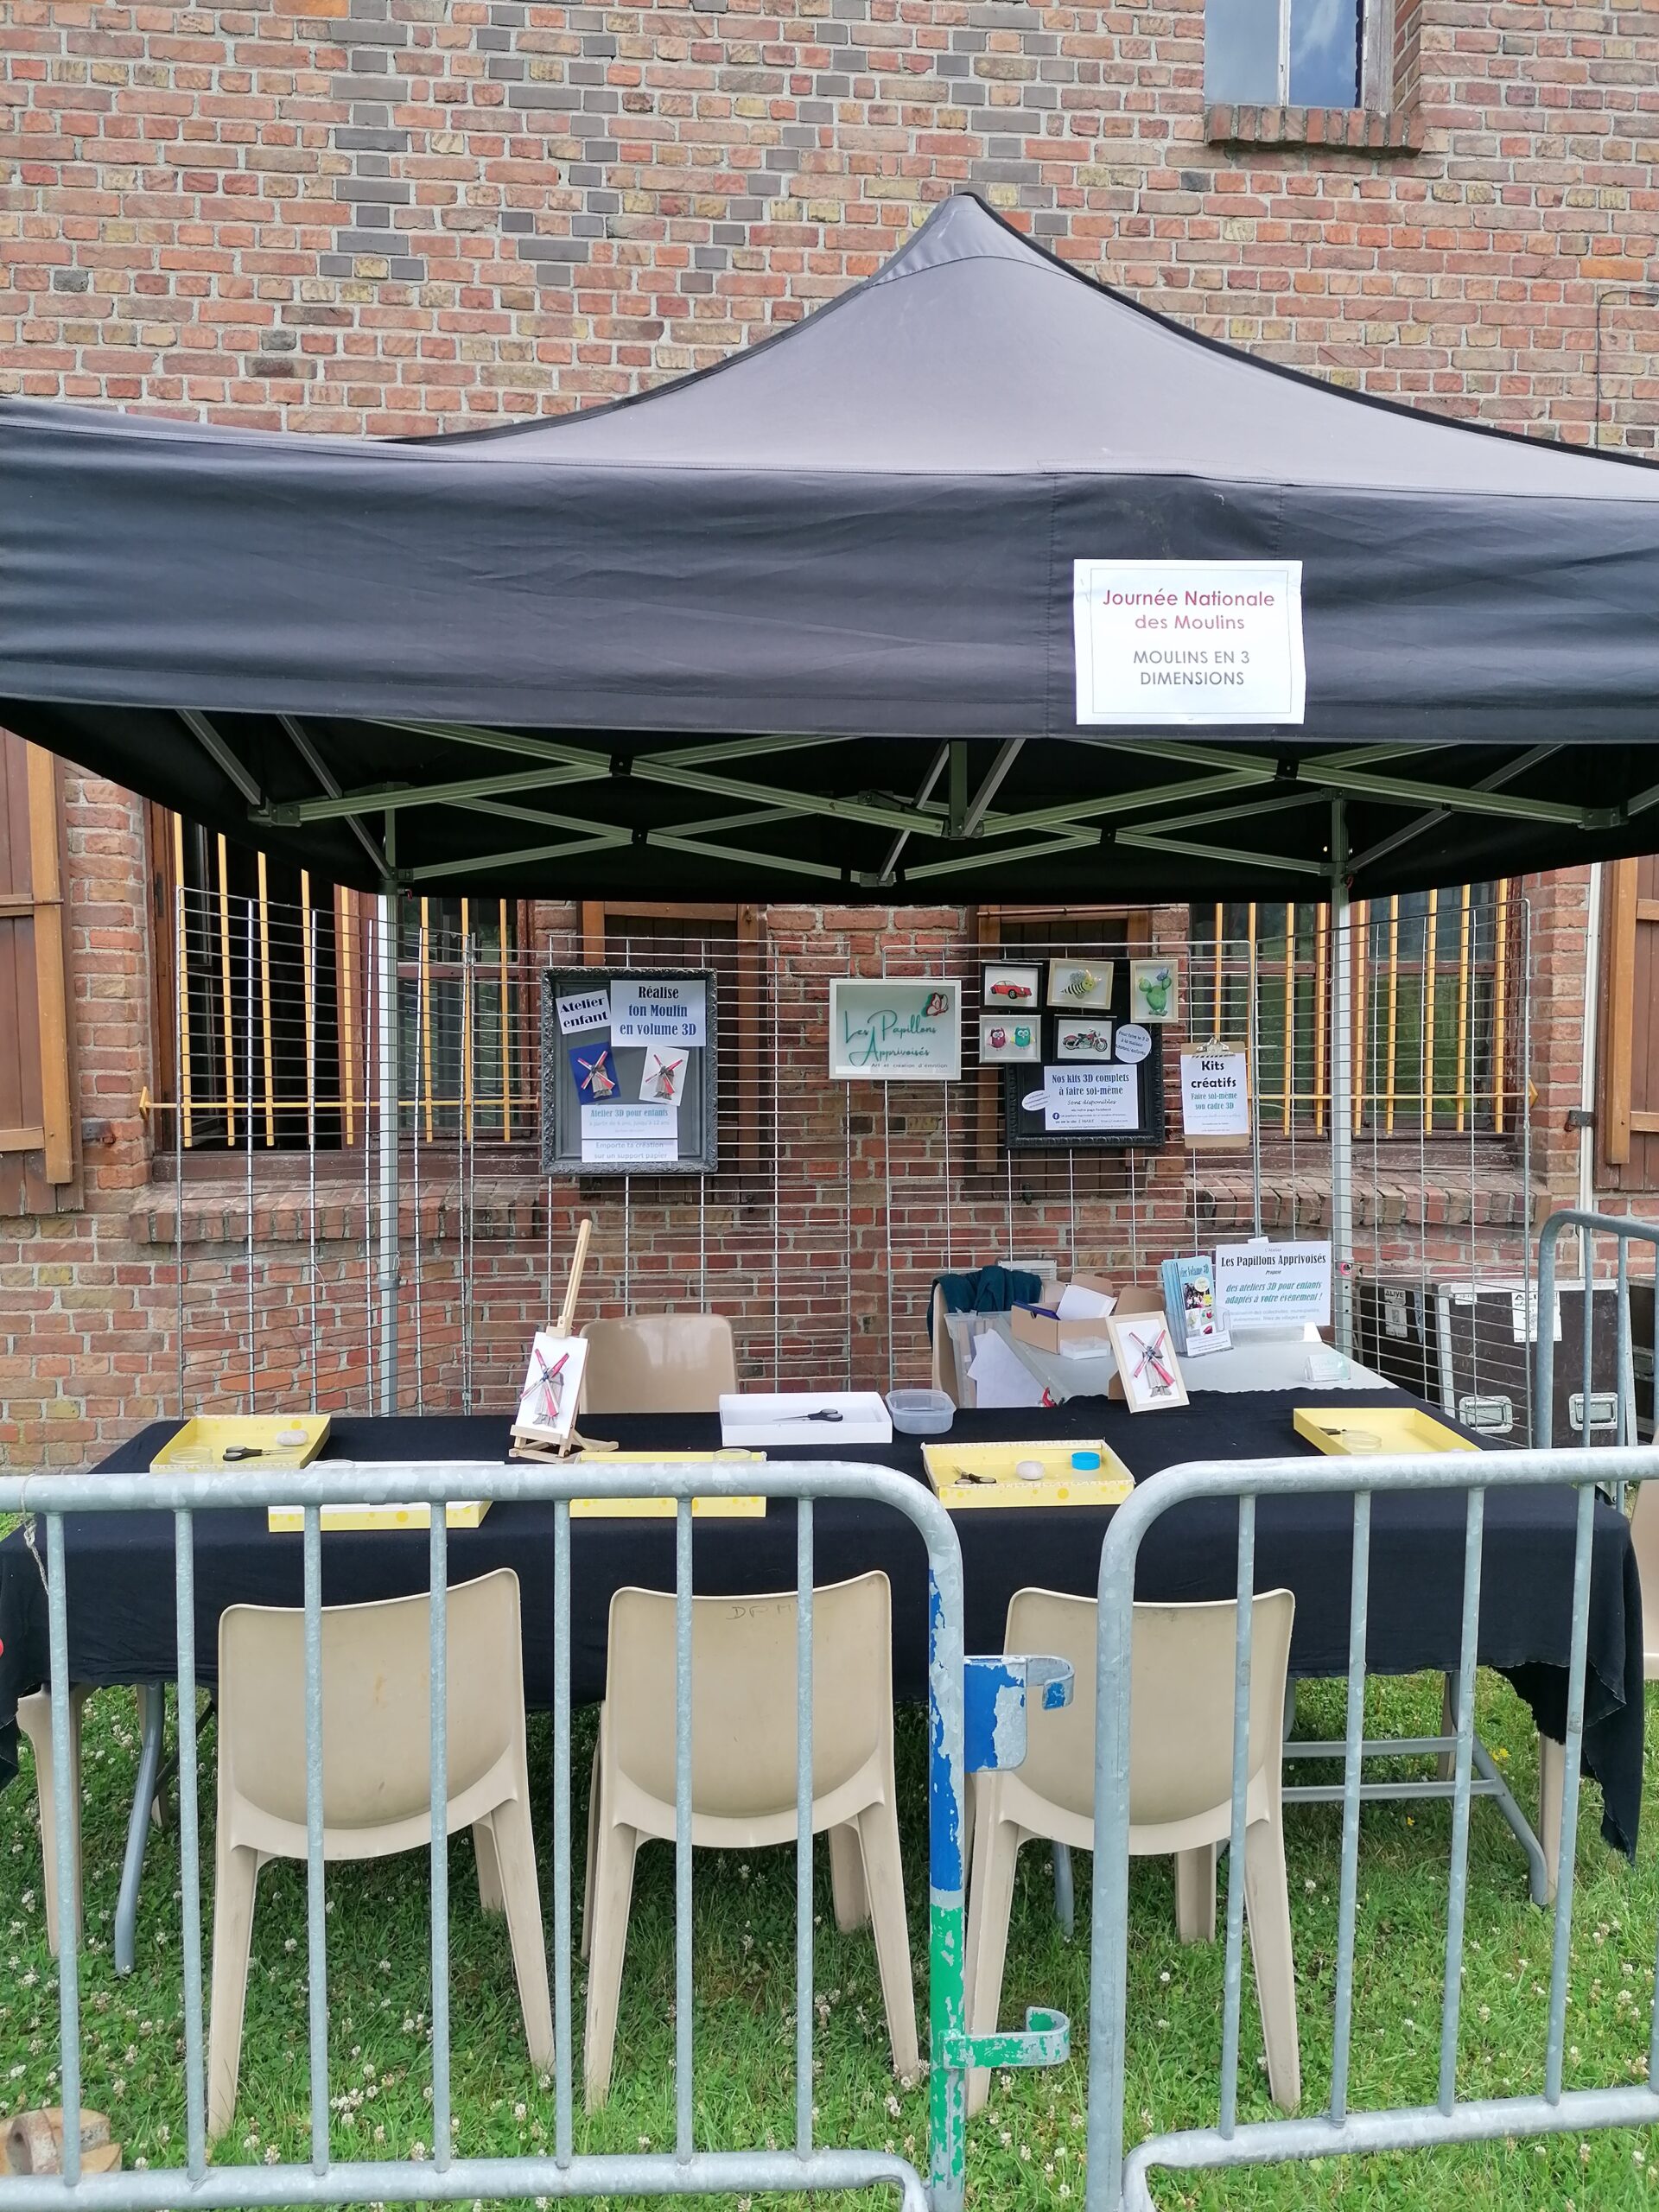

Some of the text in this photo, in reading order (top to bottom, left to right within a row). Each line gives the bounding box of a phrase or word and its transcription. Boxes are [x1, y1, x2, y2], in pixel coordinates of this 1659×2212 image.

[1103, 588, 1274, 606] Journée Nationale
[1135, 615, 1245, 629] des Moulins
[1133, 651, 1250, 664] MOULINS EN 3
[1140, 671, 1244, 685] DIMENSIONS
[638, 986, 679, 999] Réalise
[560, 997, 606, 1014] Atelier
[628, 1004, 688, 1017] ton Moulin
[563, 1011, 608, 1028] enfant
[620, 1023, 696, 1036] en volume 3D
[845, 1009, 938, 1044] Les Papillons
[849, 1026, 930, 1067] Apprivoisés
[1201, 1060, 1224, 1071] Kits
[1052, 1073, 1129, 1084] Nos kits 3D complets
[1191, 1077, 1236, 1088] créatifs
[1058, 1085, 1123, 1096] à faire soi-même
[626, 1109, 642, 1118] pour
[644, 1109, 669, 1117] enfants
[1221, 1253, 1326, 1267] Les Papillons Apprivoisés
[1225, 1281, 1322, 1293] des ateliers 3D pour enfants
[1224, 1295, 1252, 1305] adaptés
[1261, 1294, 1280, 1303] votre
[1385, 1290, 1404, 1299] ALIVE
